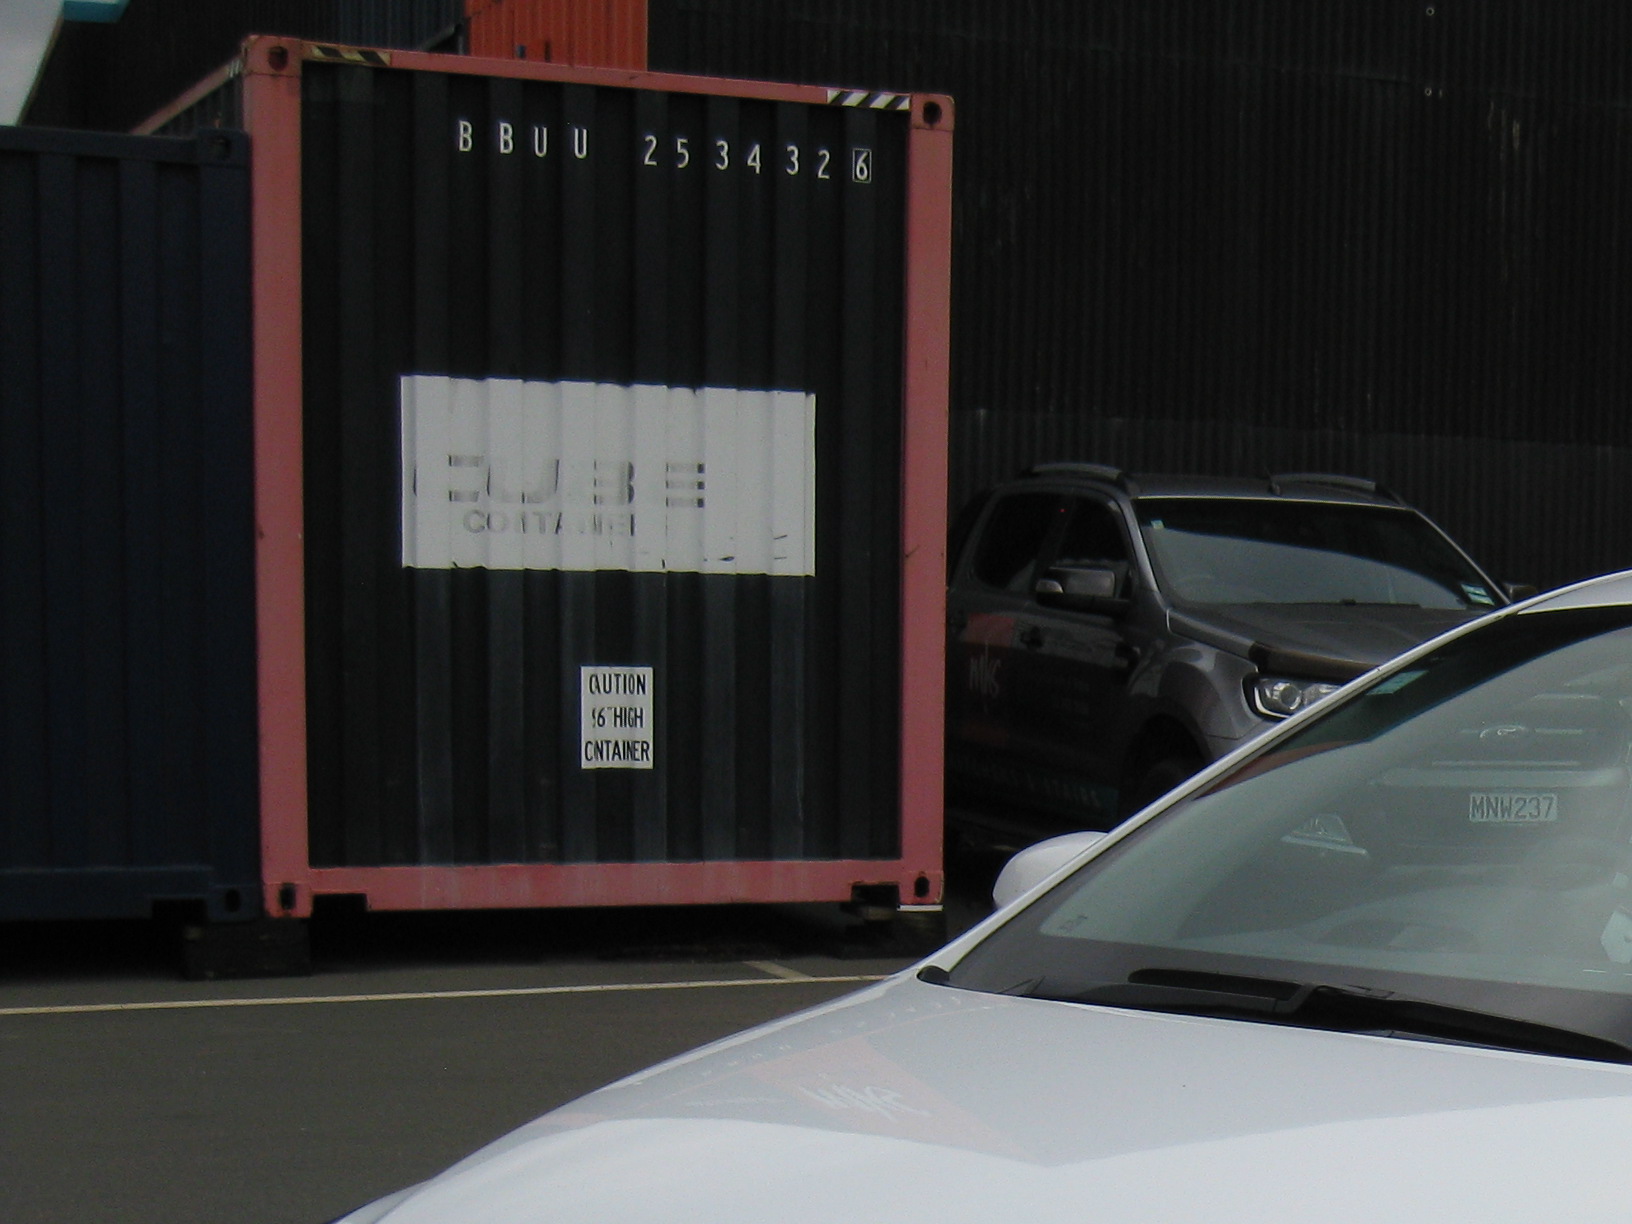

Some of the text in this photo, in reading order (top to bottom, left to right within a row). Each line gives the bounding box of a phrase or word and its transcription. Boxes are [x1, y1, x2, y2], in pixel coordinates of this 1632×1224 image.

[614, 706, 644, 728] HIGH
[585, 740, 650, 761] CNTAINER
[1471, 795, 1555, 819] MNW237
